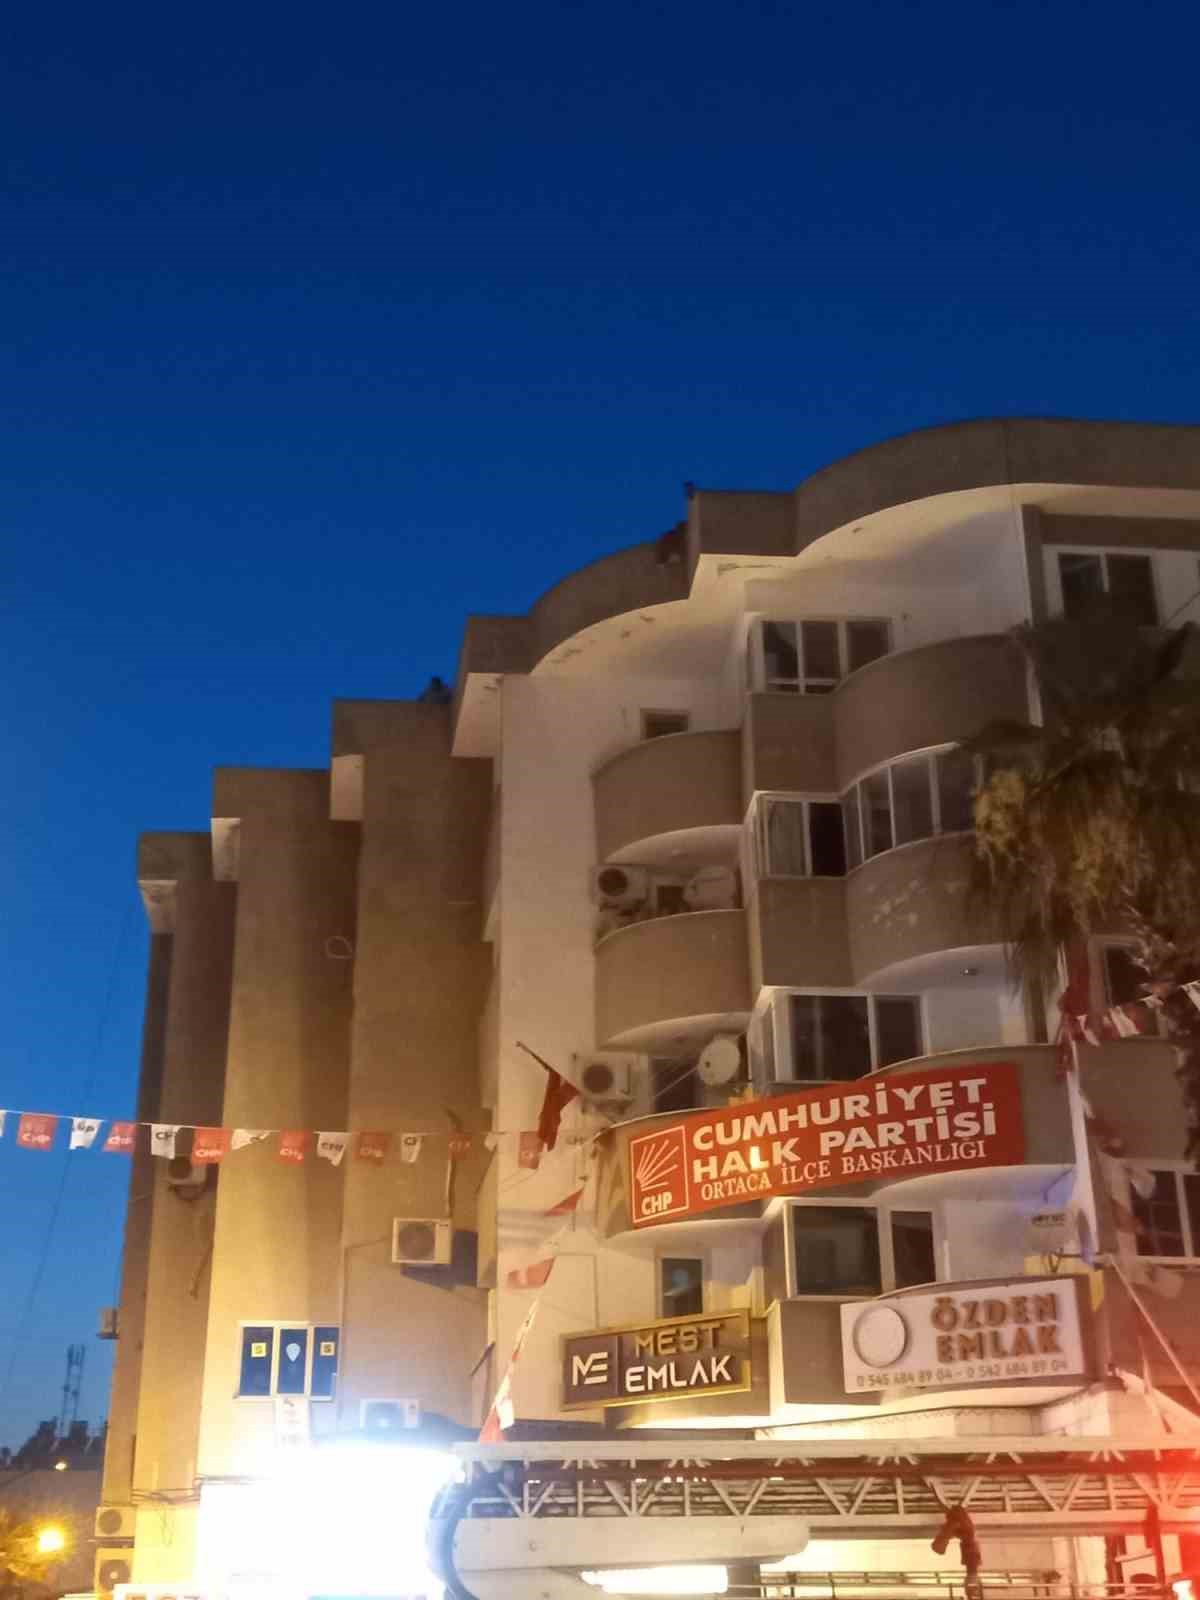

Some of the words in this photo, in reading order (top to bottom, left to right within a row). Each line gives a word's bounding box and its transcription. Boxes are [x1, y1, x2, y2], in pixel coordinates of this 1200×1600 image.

[693, 1079, 987, 1150] CUMHURİYET
[693, 1138, 801, 1184] HALK
[820, 1103, 996, 1156] PARTİSİ
[702, 1171, 772, 1200] ORTACA
[781, 1160, 831, 1184] İLÇE
[842, 1138, 986, 1174] BAŞKANLIĞI
[642, 1192, 672, 1215] CHP
[931, 1294, 1058, 1331] ÖZDEN
[634, 1323, 724, 1359] MEST
[936, 1326, 1061, 1363] EMLAK
[625, 1355, 732, 1393] EMLAK
